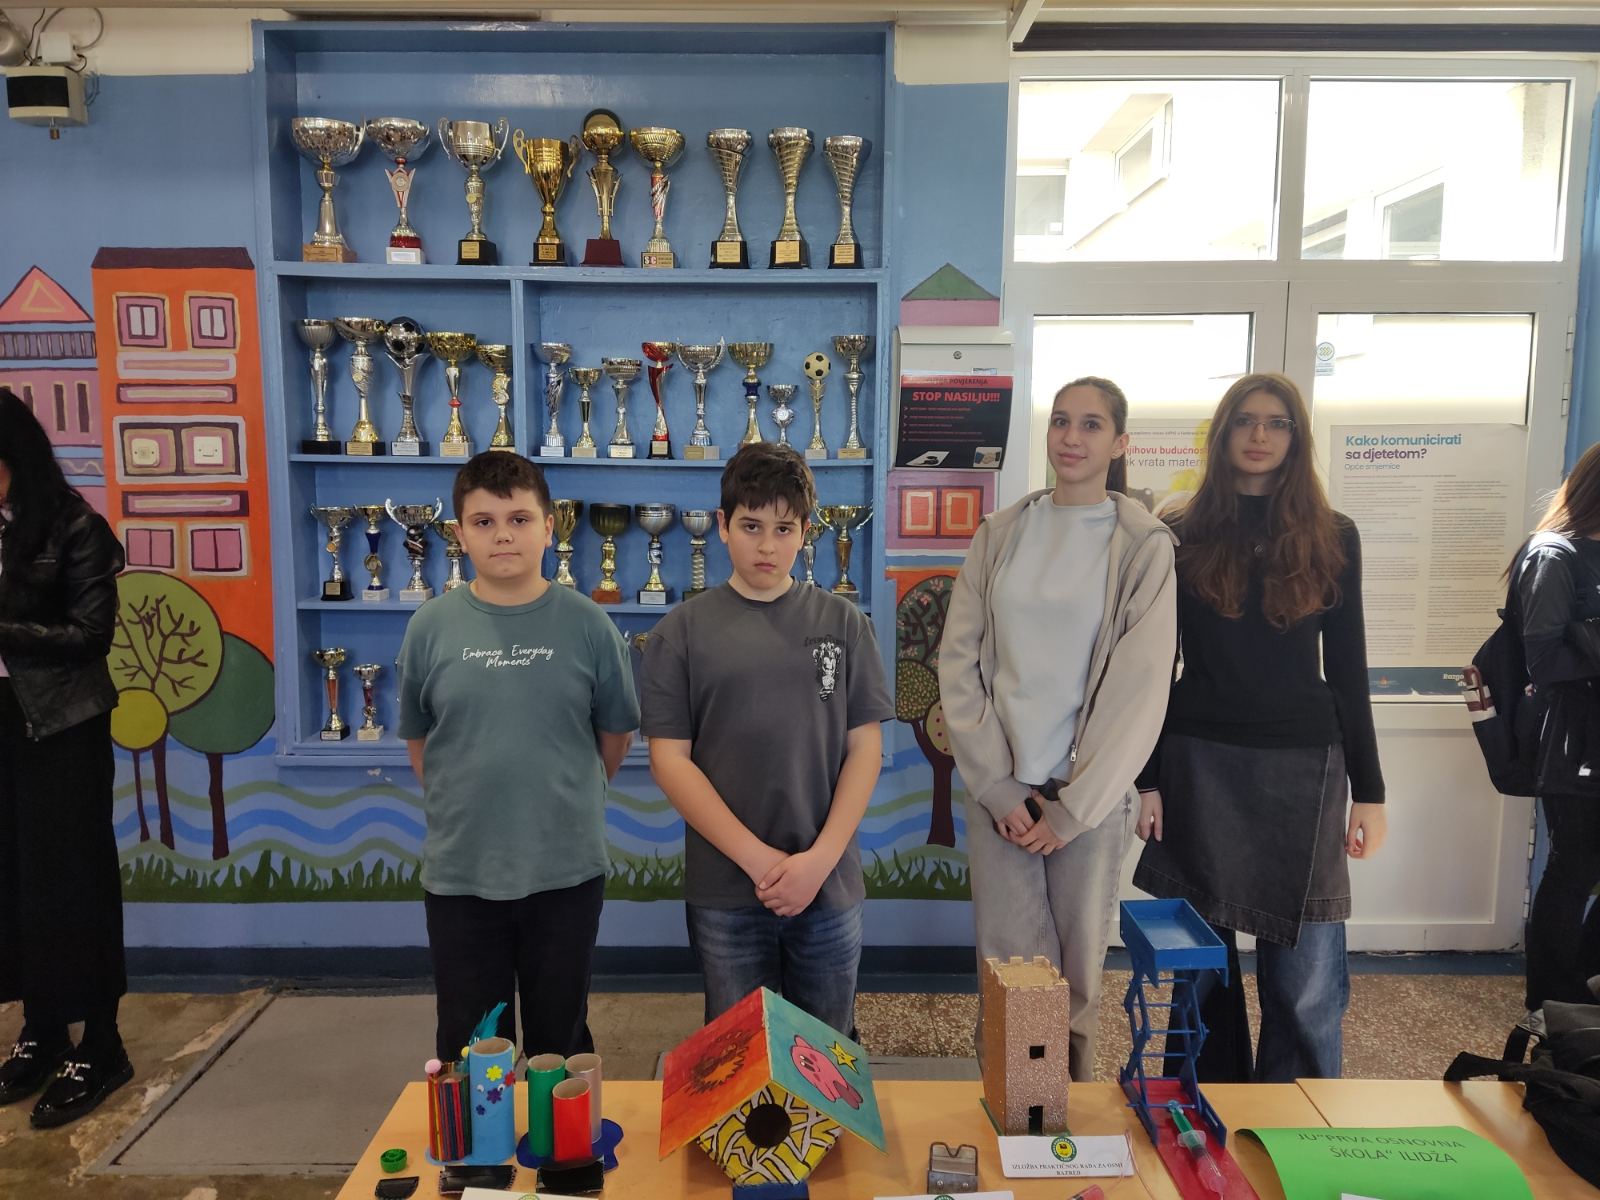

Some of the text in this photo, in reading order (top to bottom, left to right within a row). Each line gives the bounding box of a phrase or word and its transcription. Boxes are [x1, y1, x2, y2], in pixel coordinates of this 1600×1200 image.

[912, 391, 1000, 404] STOP NASILJU!!!
[1345, 433, 1462, 446] Kako komunicirati
[1345, 448, 1427, 462] sa djetetom?
[1138, 459, 1165, 467] vrata
[462, 644, 554, 660] Embrace Everyday
[485, 656, 531, 668] Moments
[1443, 673, 1465, 681] Razgo
[1375, 1136, 1467, 1149] OSNOVNA
[1397, 1149, 1458, 1164] ILIDŽA
